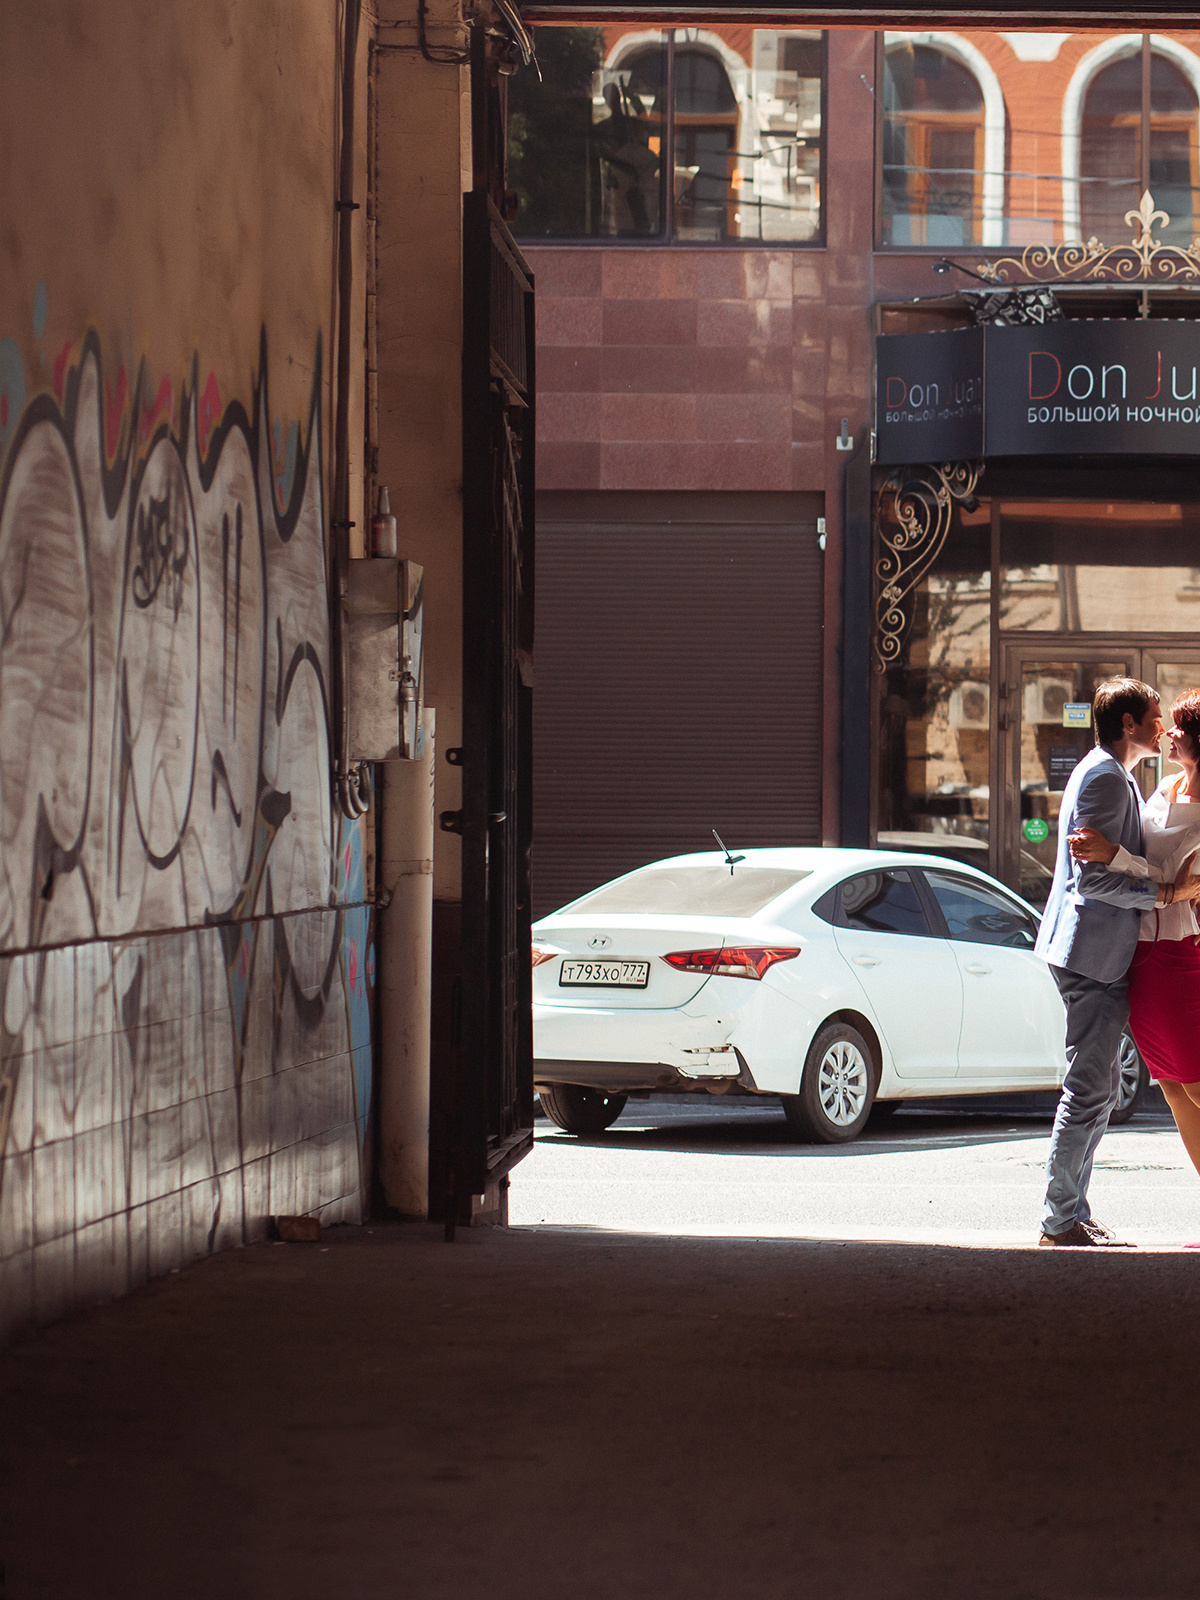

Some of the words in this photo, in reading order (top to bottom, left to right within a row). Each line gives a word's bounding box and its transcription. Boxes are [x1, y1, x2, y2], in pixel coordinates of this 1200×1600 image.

[1029, 351, 1127, 400] Don
[887, 377, 939, 408] Don
[1027, 404, 1120, 424] БОЛЬШОЙ
[623, 964, 644, 977] 777
